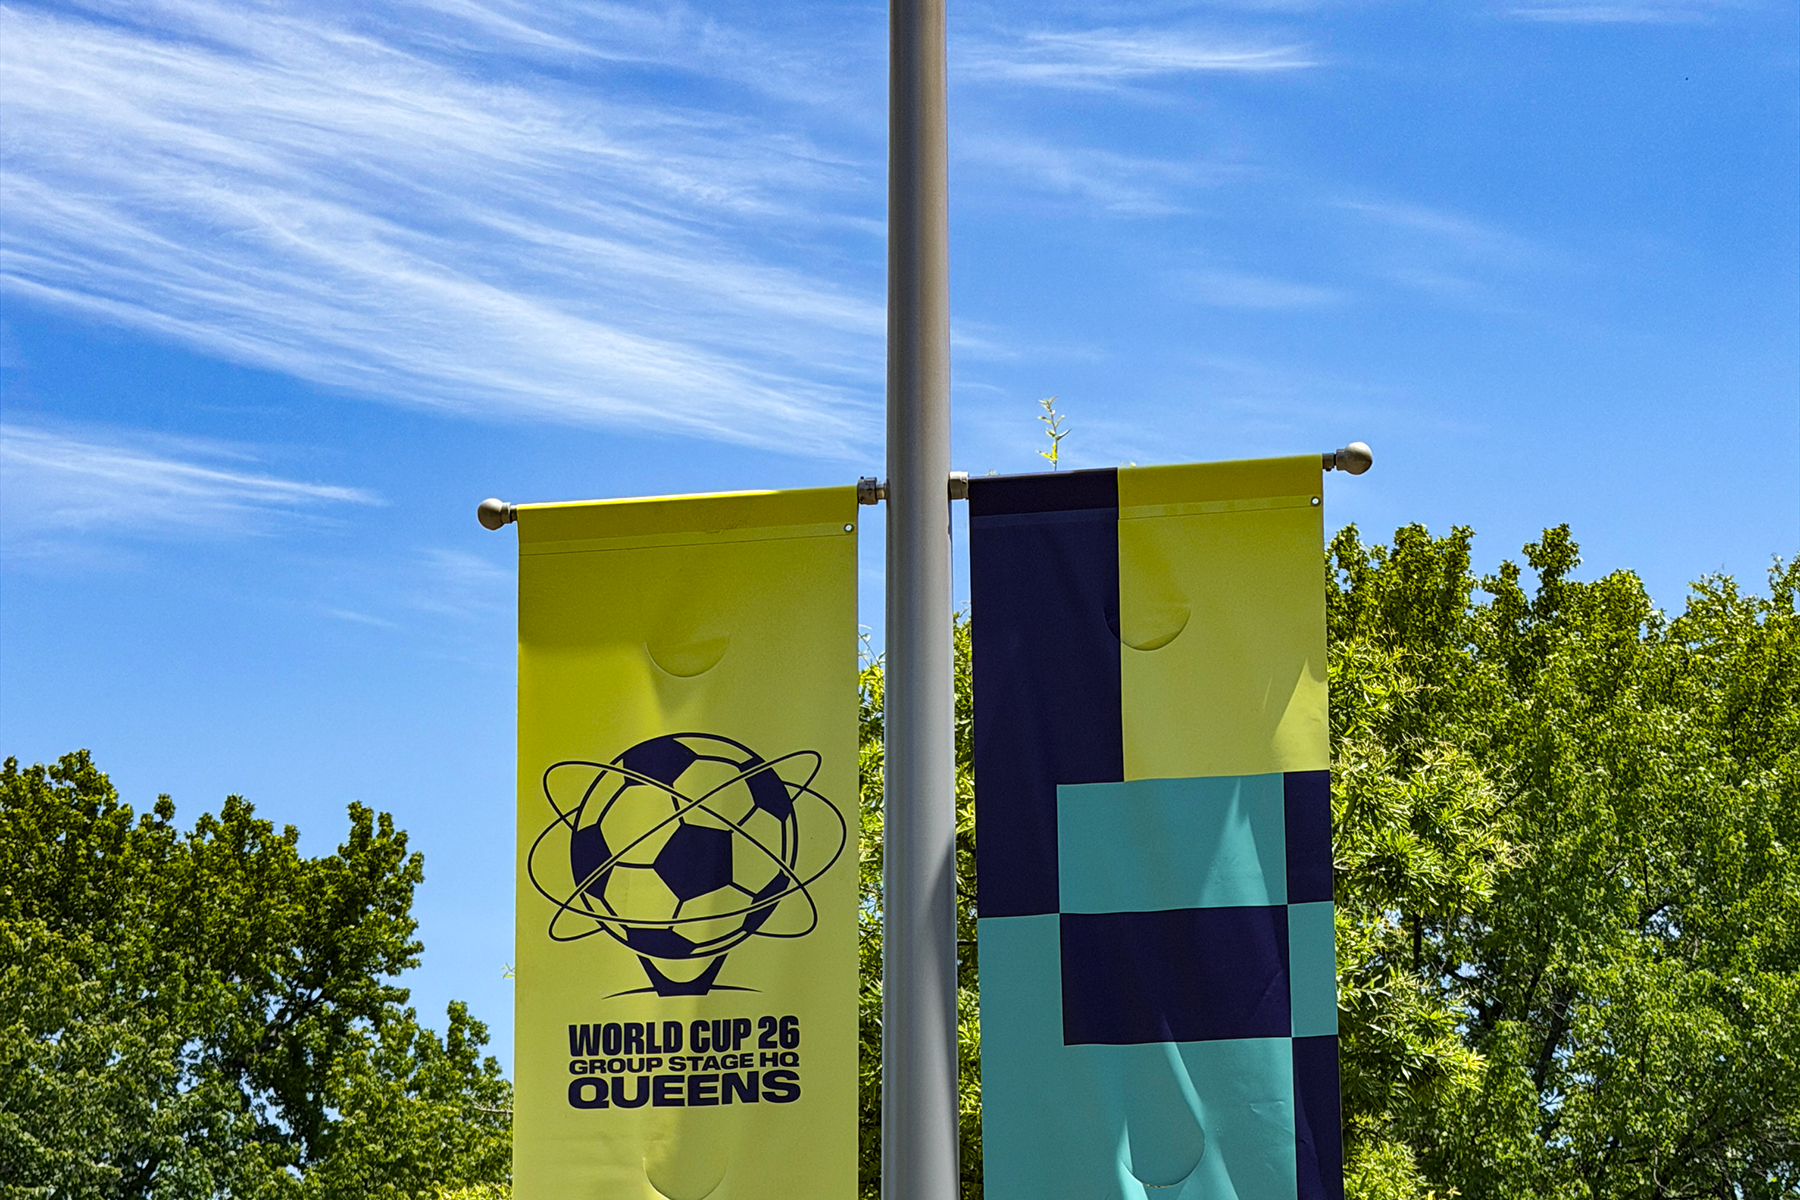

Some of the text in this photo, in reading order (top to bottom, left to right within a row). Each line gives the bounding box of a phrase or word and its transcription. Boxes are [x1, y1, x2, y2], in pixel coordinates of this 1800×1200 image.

[568, 1015, 800, 1057] WORLD CUP 26
[569, 1051, 800, 1075] GROUP STAGE HQ
[567, 1069, 801, 1109] QUEENS
